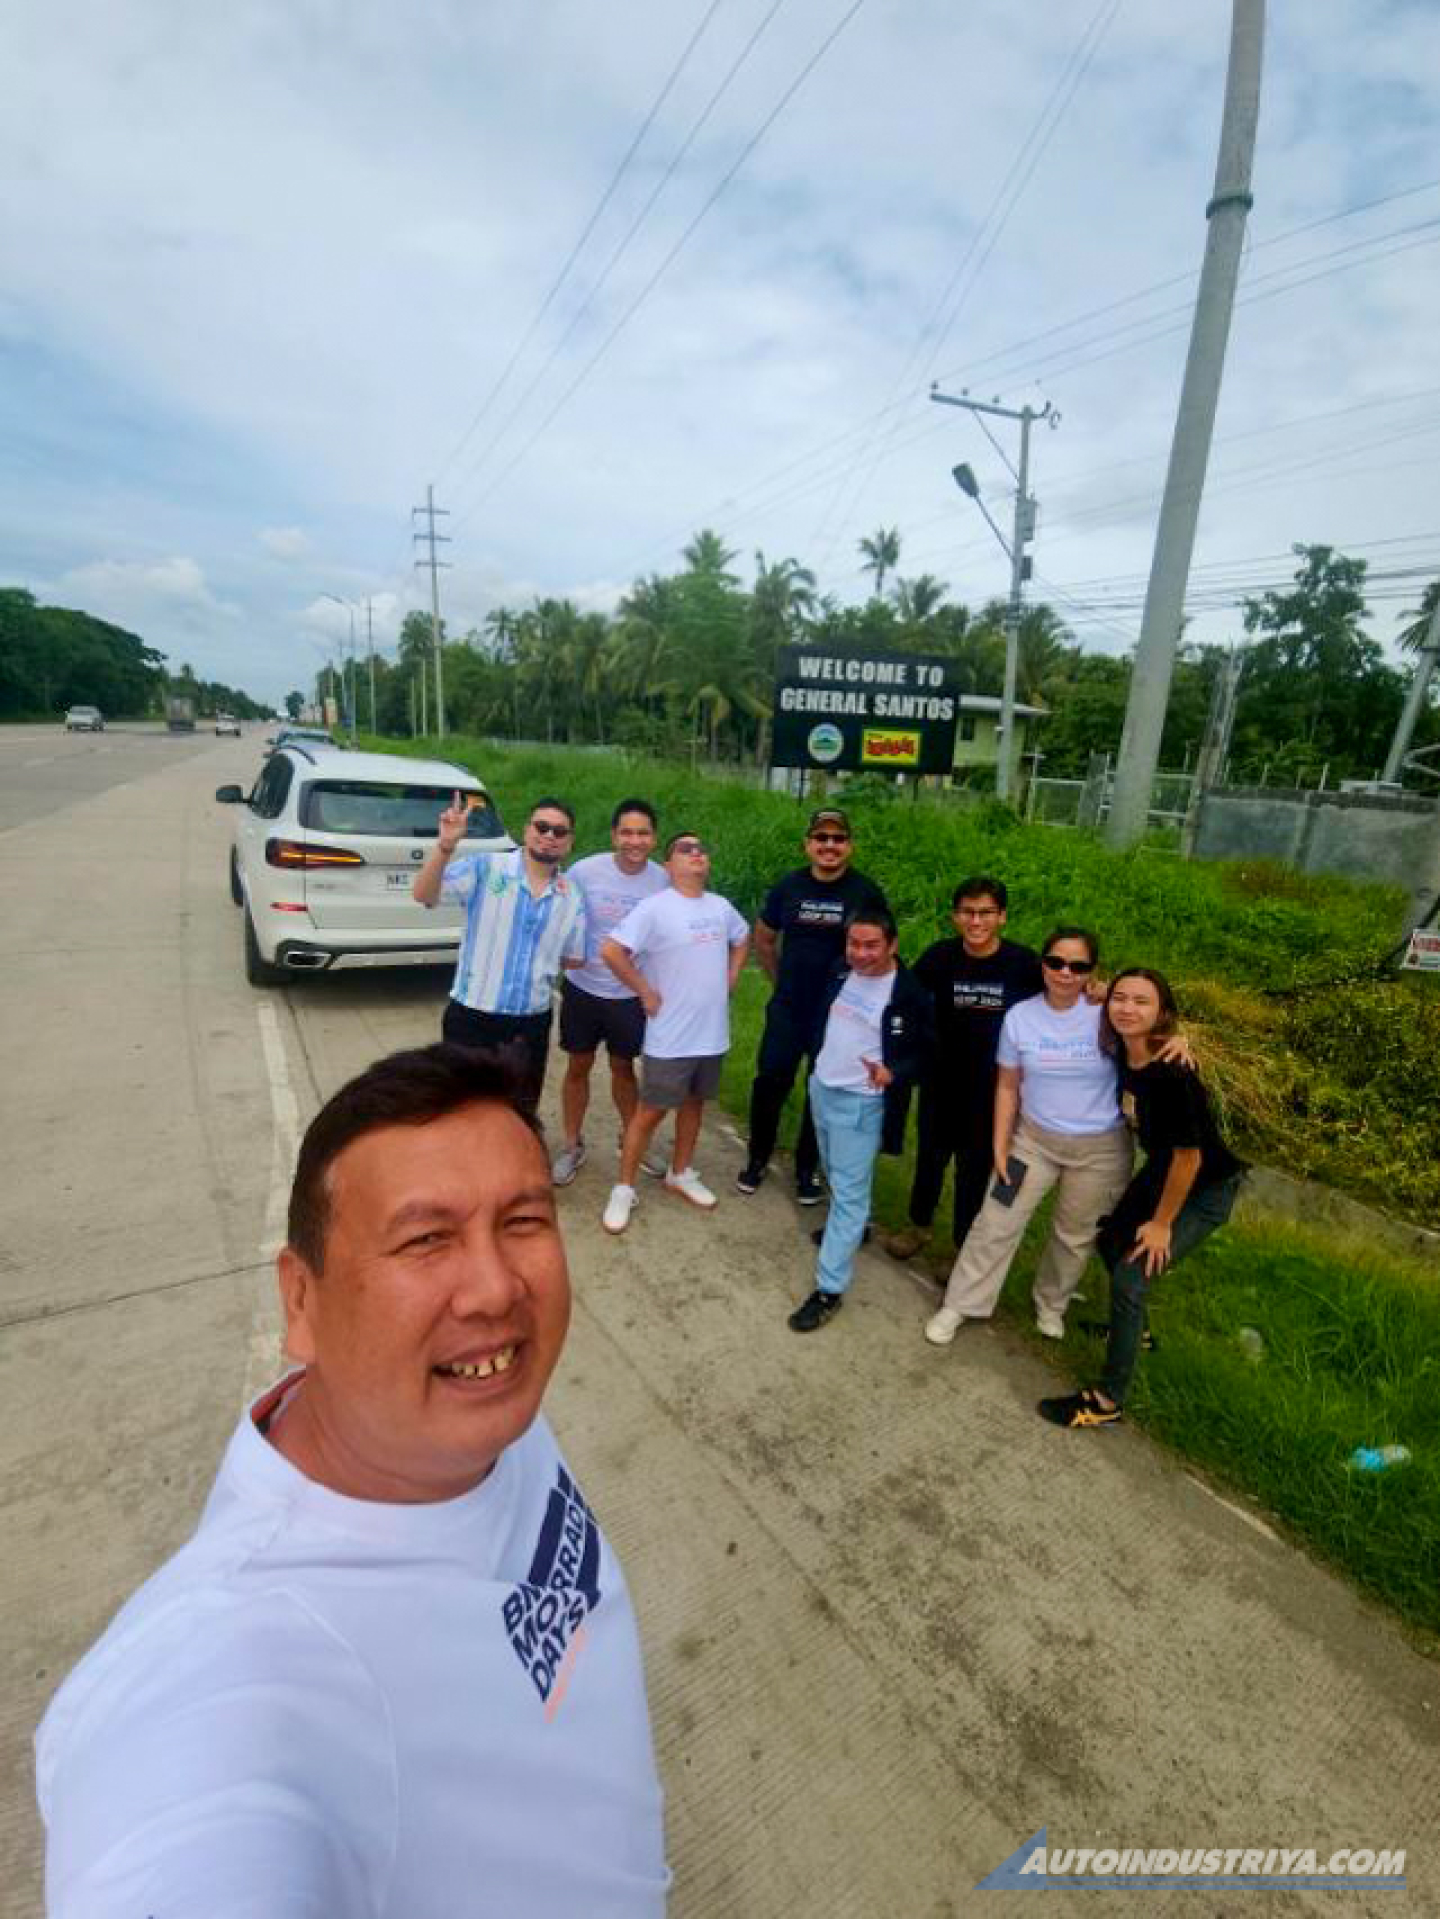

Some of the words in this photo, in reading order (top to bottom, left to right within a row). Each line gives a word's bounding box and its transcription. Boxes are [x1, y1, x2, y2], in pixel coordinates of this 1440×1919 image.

[799, 656, 907, 684] WELCOME
[916, 665, 944, 687] TO
[781, 687, 868, 714] GENERAL
[874, 693, 953, 720] SANTOS
[531, 1596, 584, 1703] DAYS
